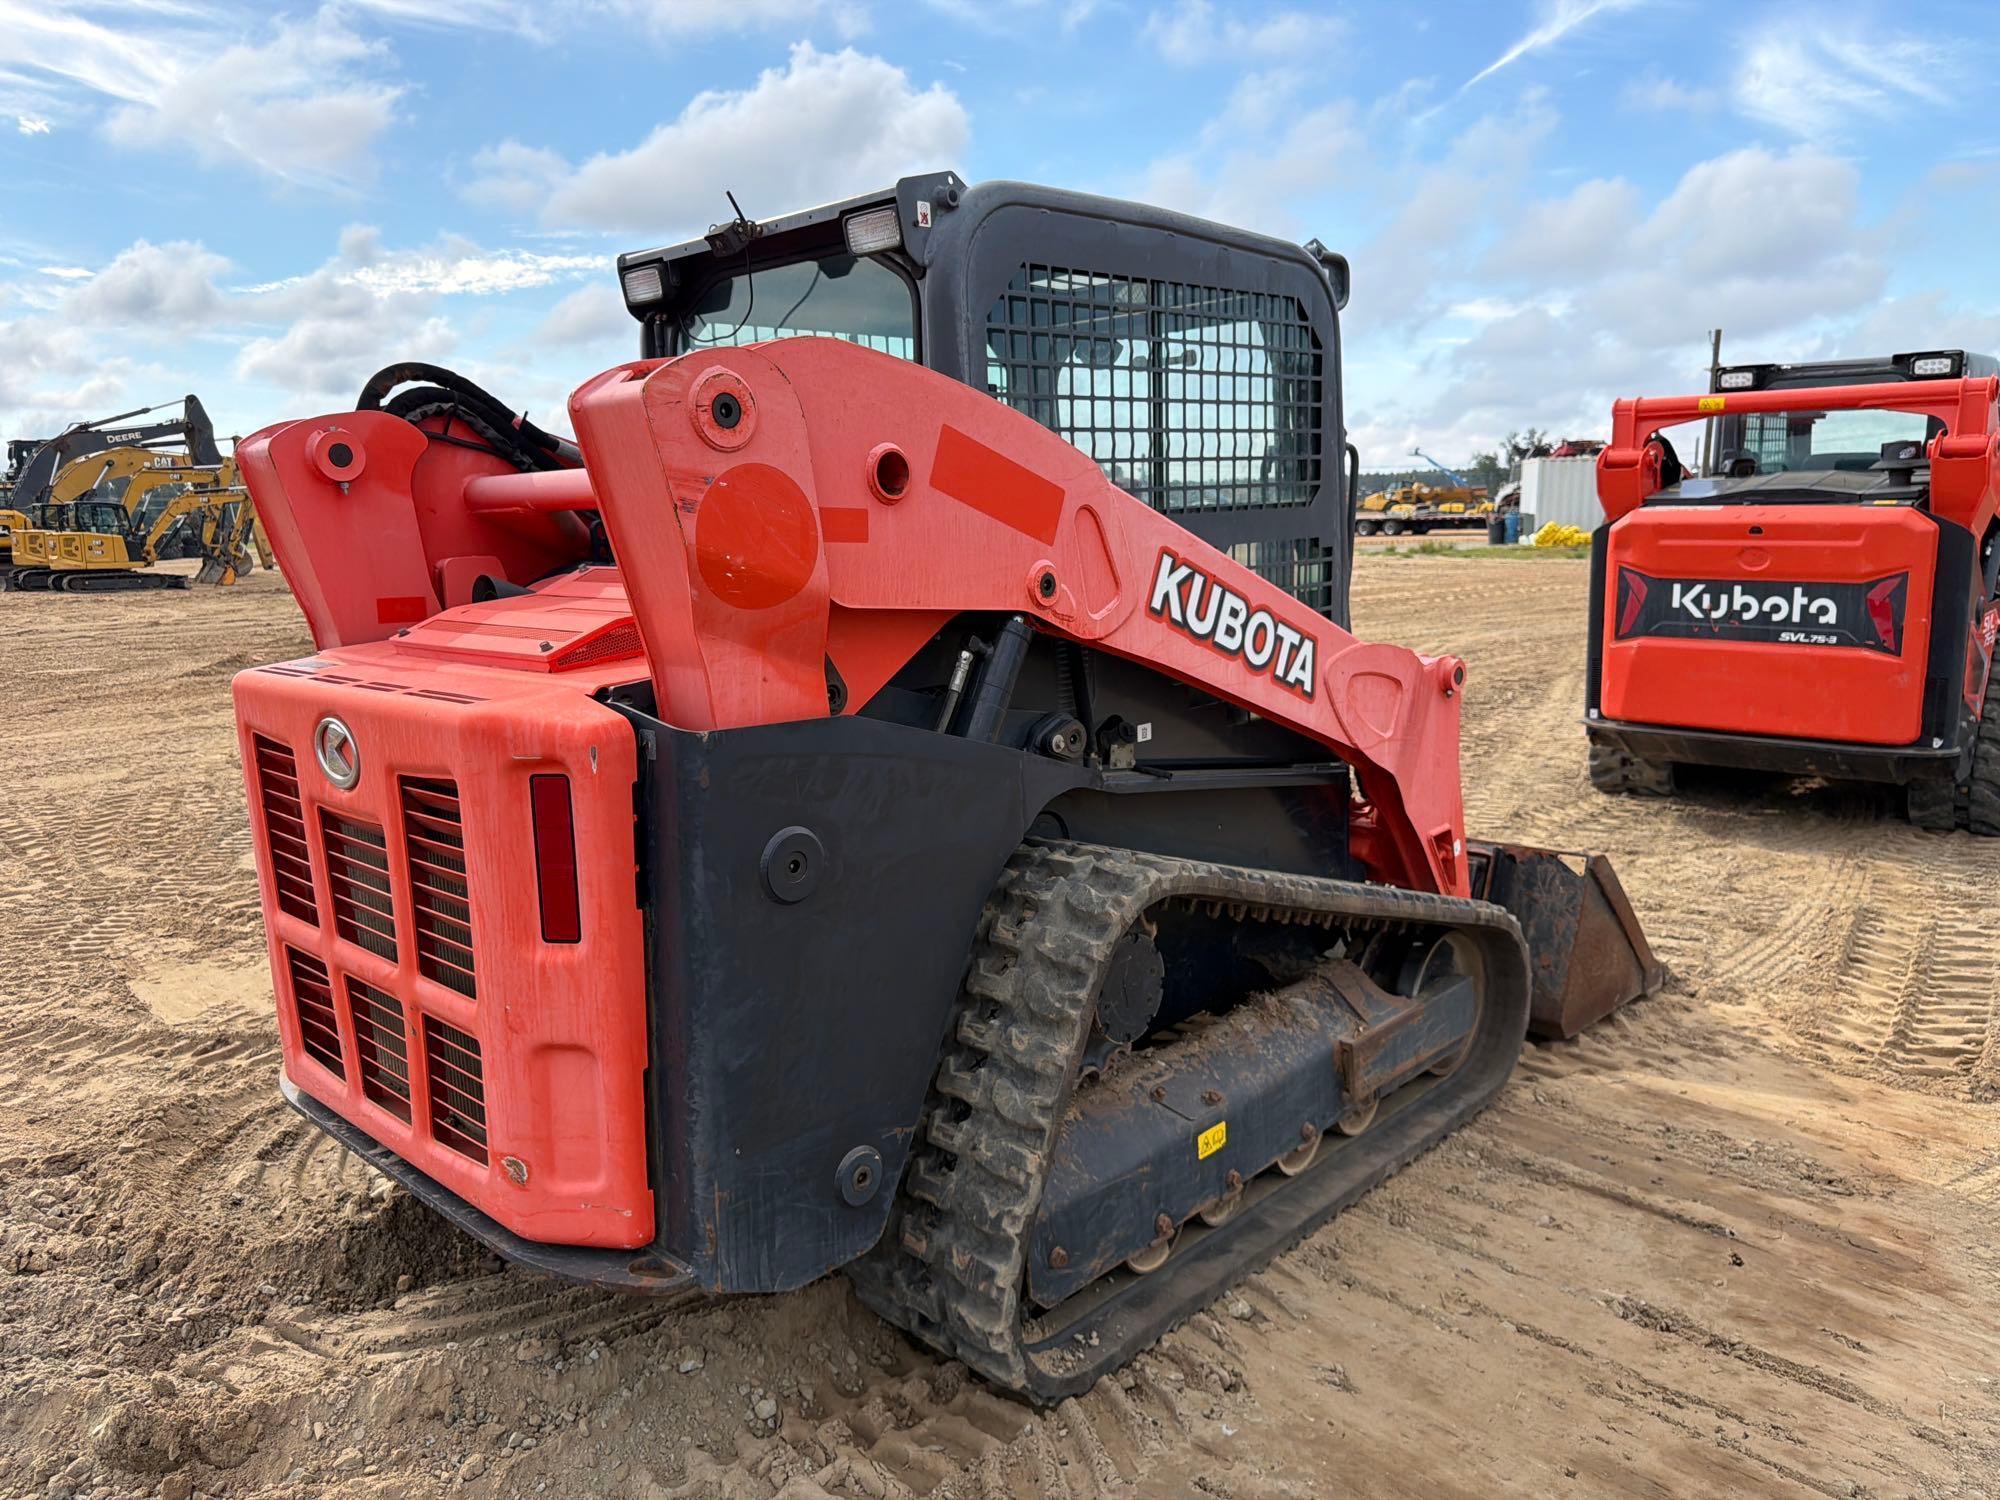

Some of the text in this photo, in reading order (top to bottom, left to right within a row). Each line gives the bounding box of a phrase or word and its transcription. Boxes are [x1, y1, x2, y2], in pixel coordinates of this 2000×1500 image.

[106, 431, 143, 444] DEERE
[153, 456, 173, 469] CAT
[1671, 583, 1838, 625] Kubota
[1150, 552, 1315, 694] KUBOTA
